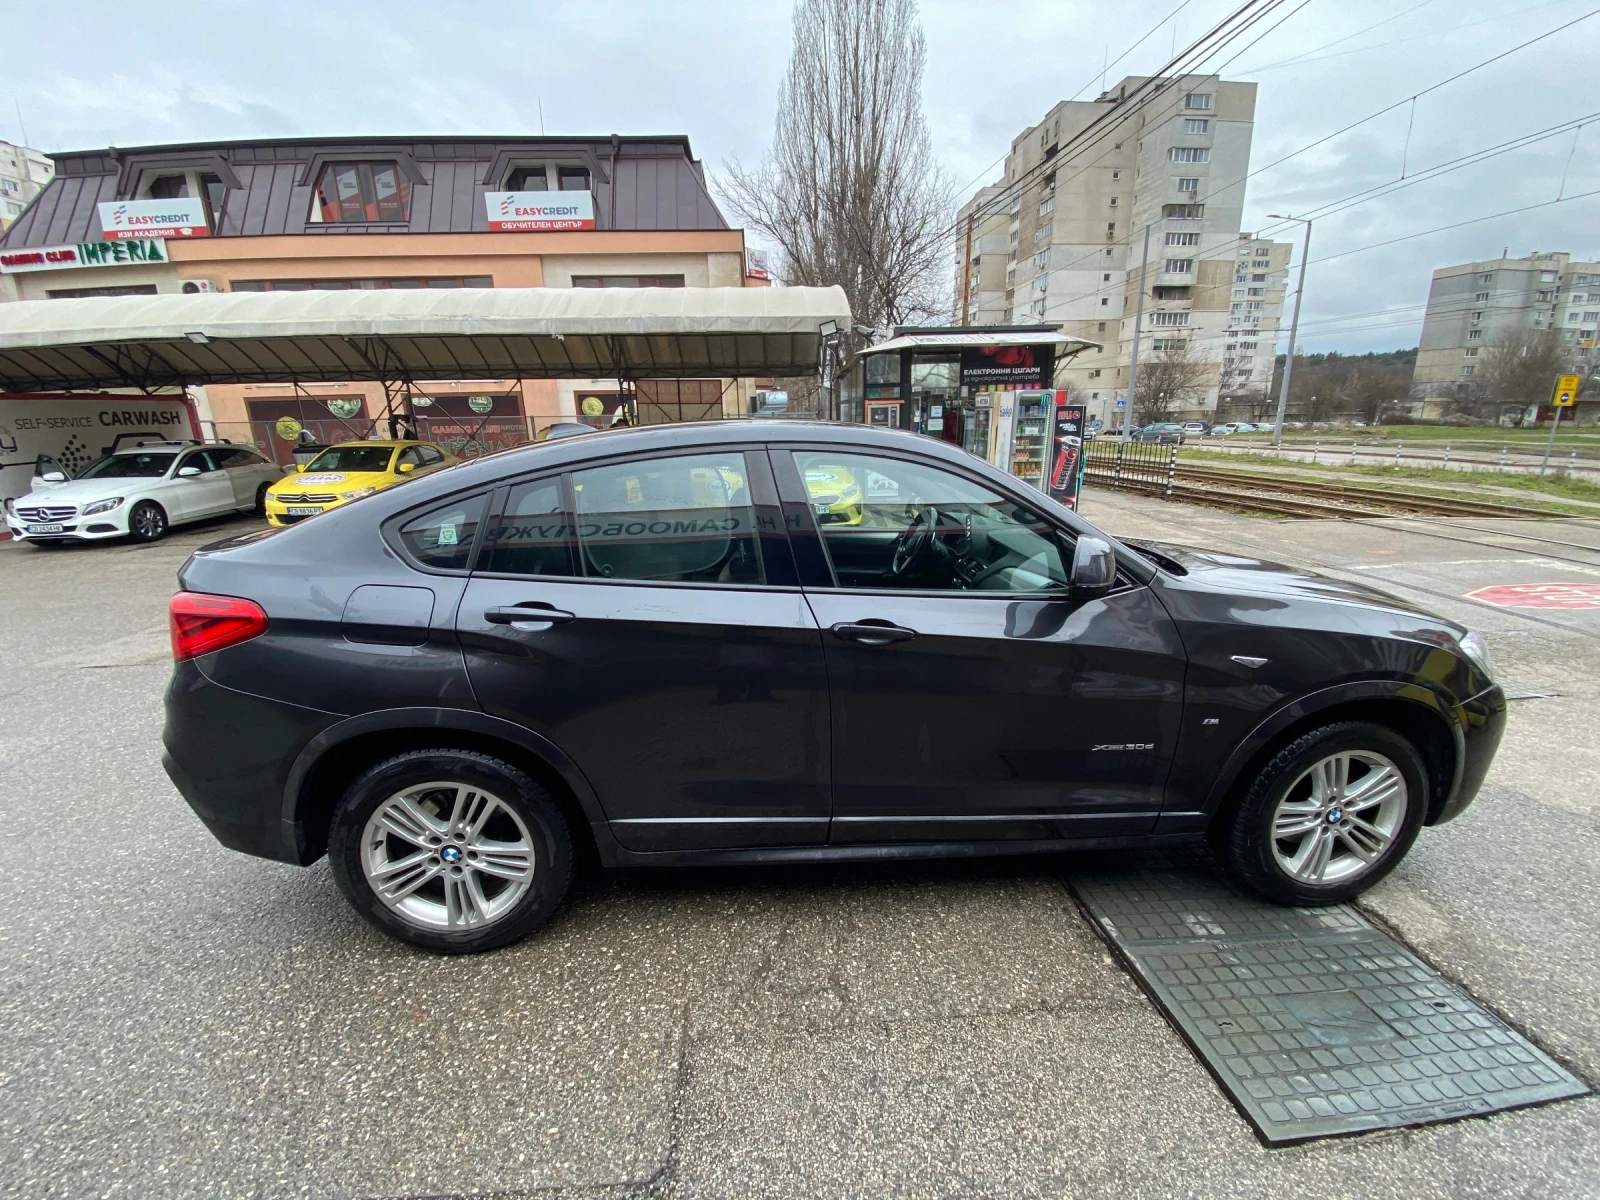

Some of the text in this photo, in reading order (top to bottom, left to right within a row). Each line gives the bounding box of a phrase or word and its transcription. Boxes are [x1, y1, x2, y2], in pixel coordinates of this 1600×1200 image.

[515, 207, 578, 216] EASYCREDIT
[128, 214, 190, 225] EASYCREDIT
[118, 229, 175, 238] ИЗИ АКАДЕМИЯ
[77, 240, 164, 265] IMPERIA
[1012, 367, 1040, 375] ЦИГАРИ
[14, 411, 181, 430] SELF-SERVICE CARWASH
[432, 425, 472, 434] GAMING
